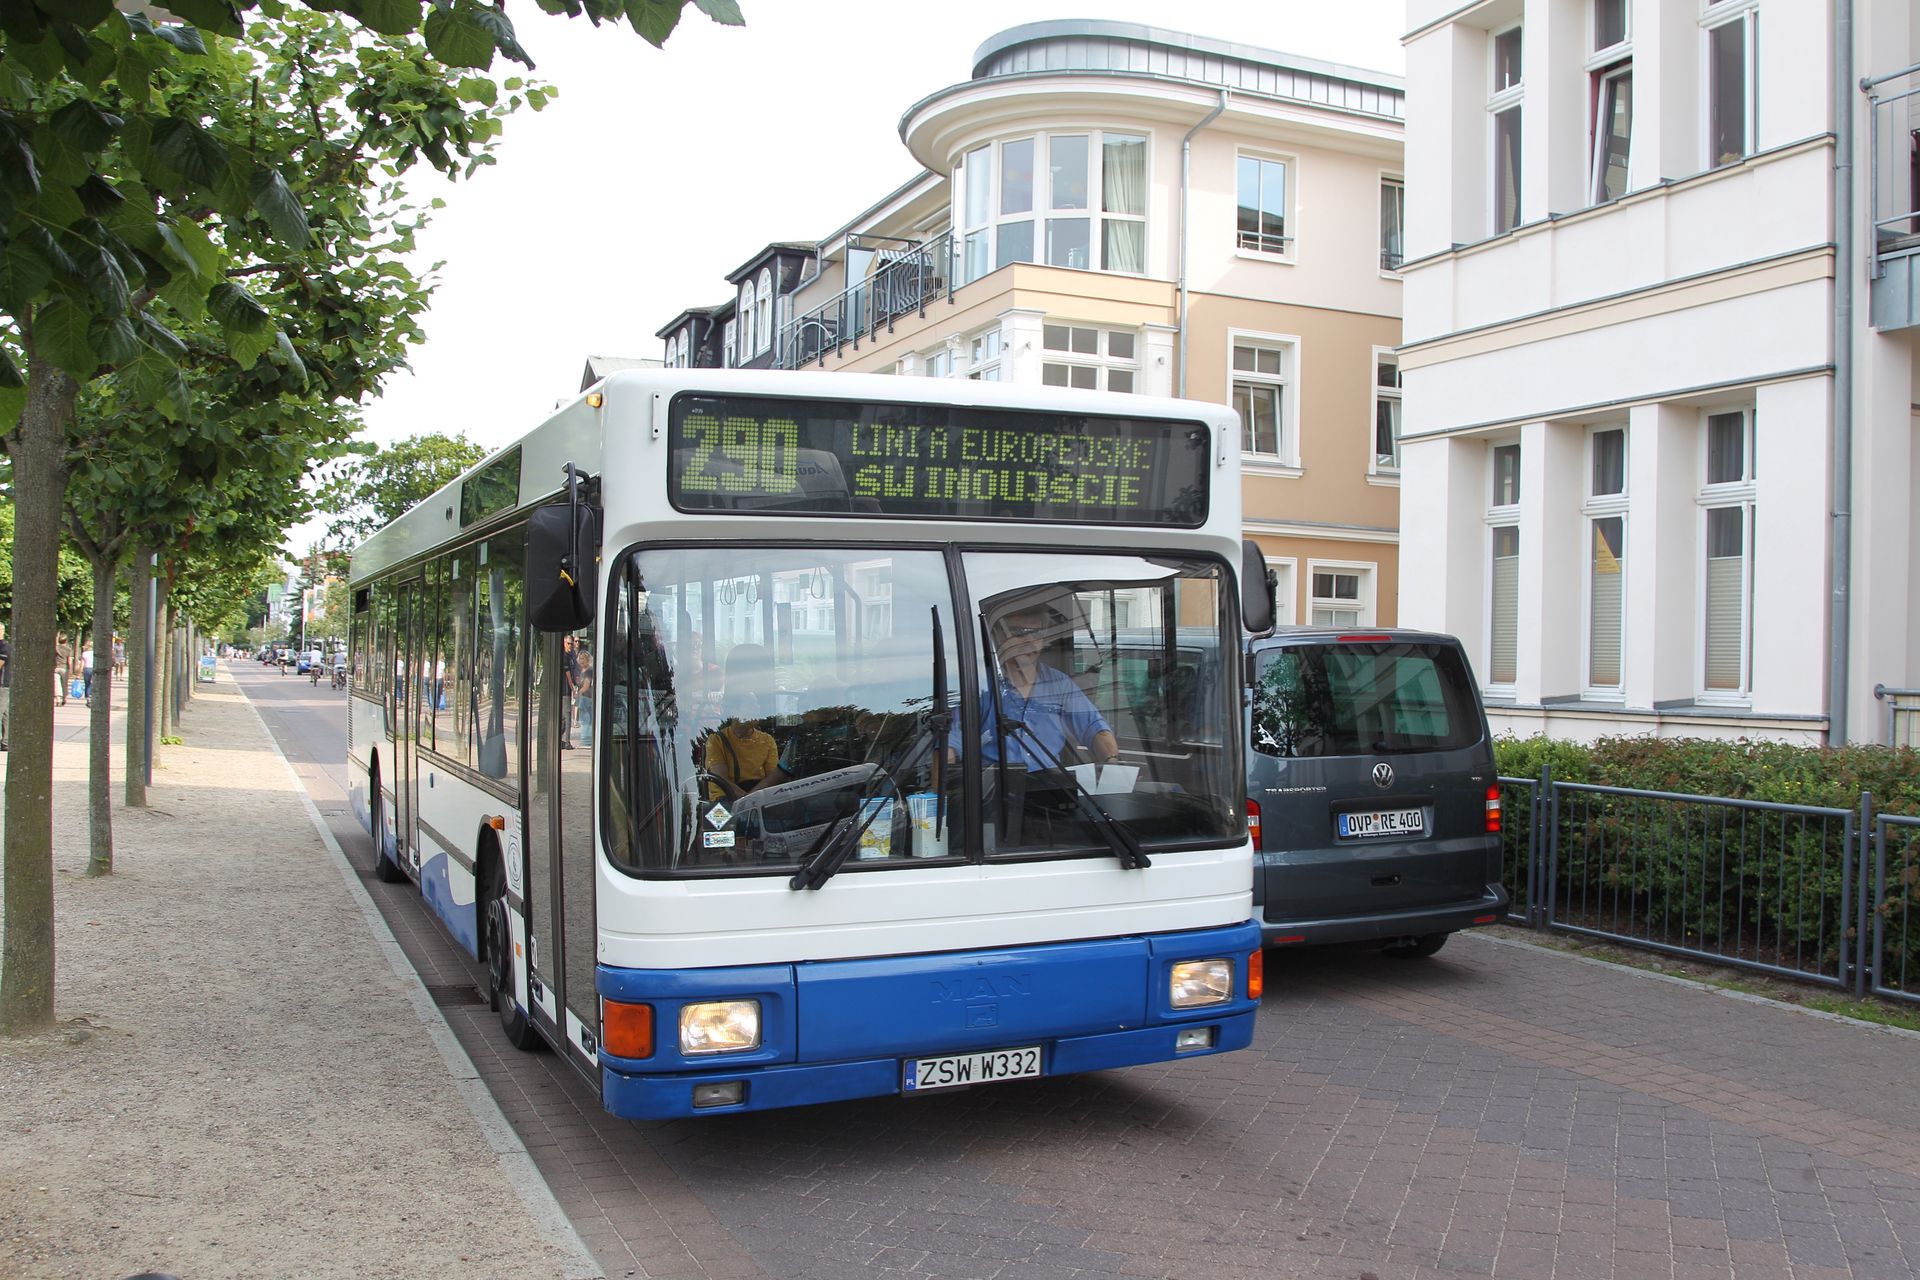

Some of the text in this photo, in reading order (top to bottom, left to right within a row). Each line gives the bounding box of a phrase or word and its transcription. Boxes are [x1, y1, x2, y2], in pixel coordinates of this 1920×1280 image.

[681, 415, 798, 493] 290
[1348, 811, 1421, 833] OVP RE 400
[929, 973, 1032, 1004] MAN
[905, 1078, 915, 1086] PL
[920, 1050, 1037, 1087] ZSW W332
